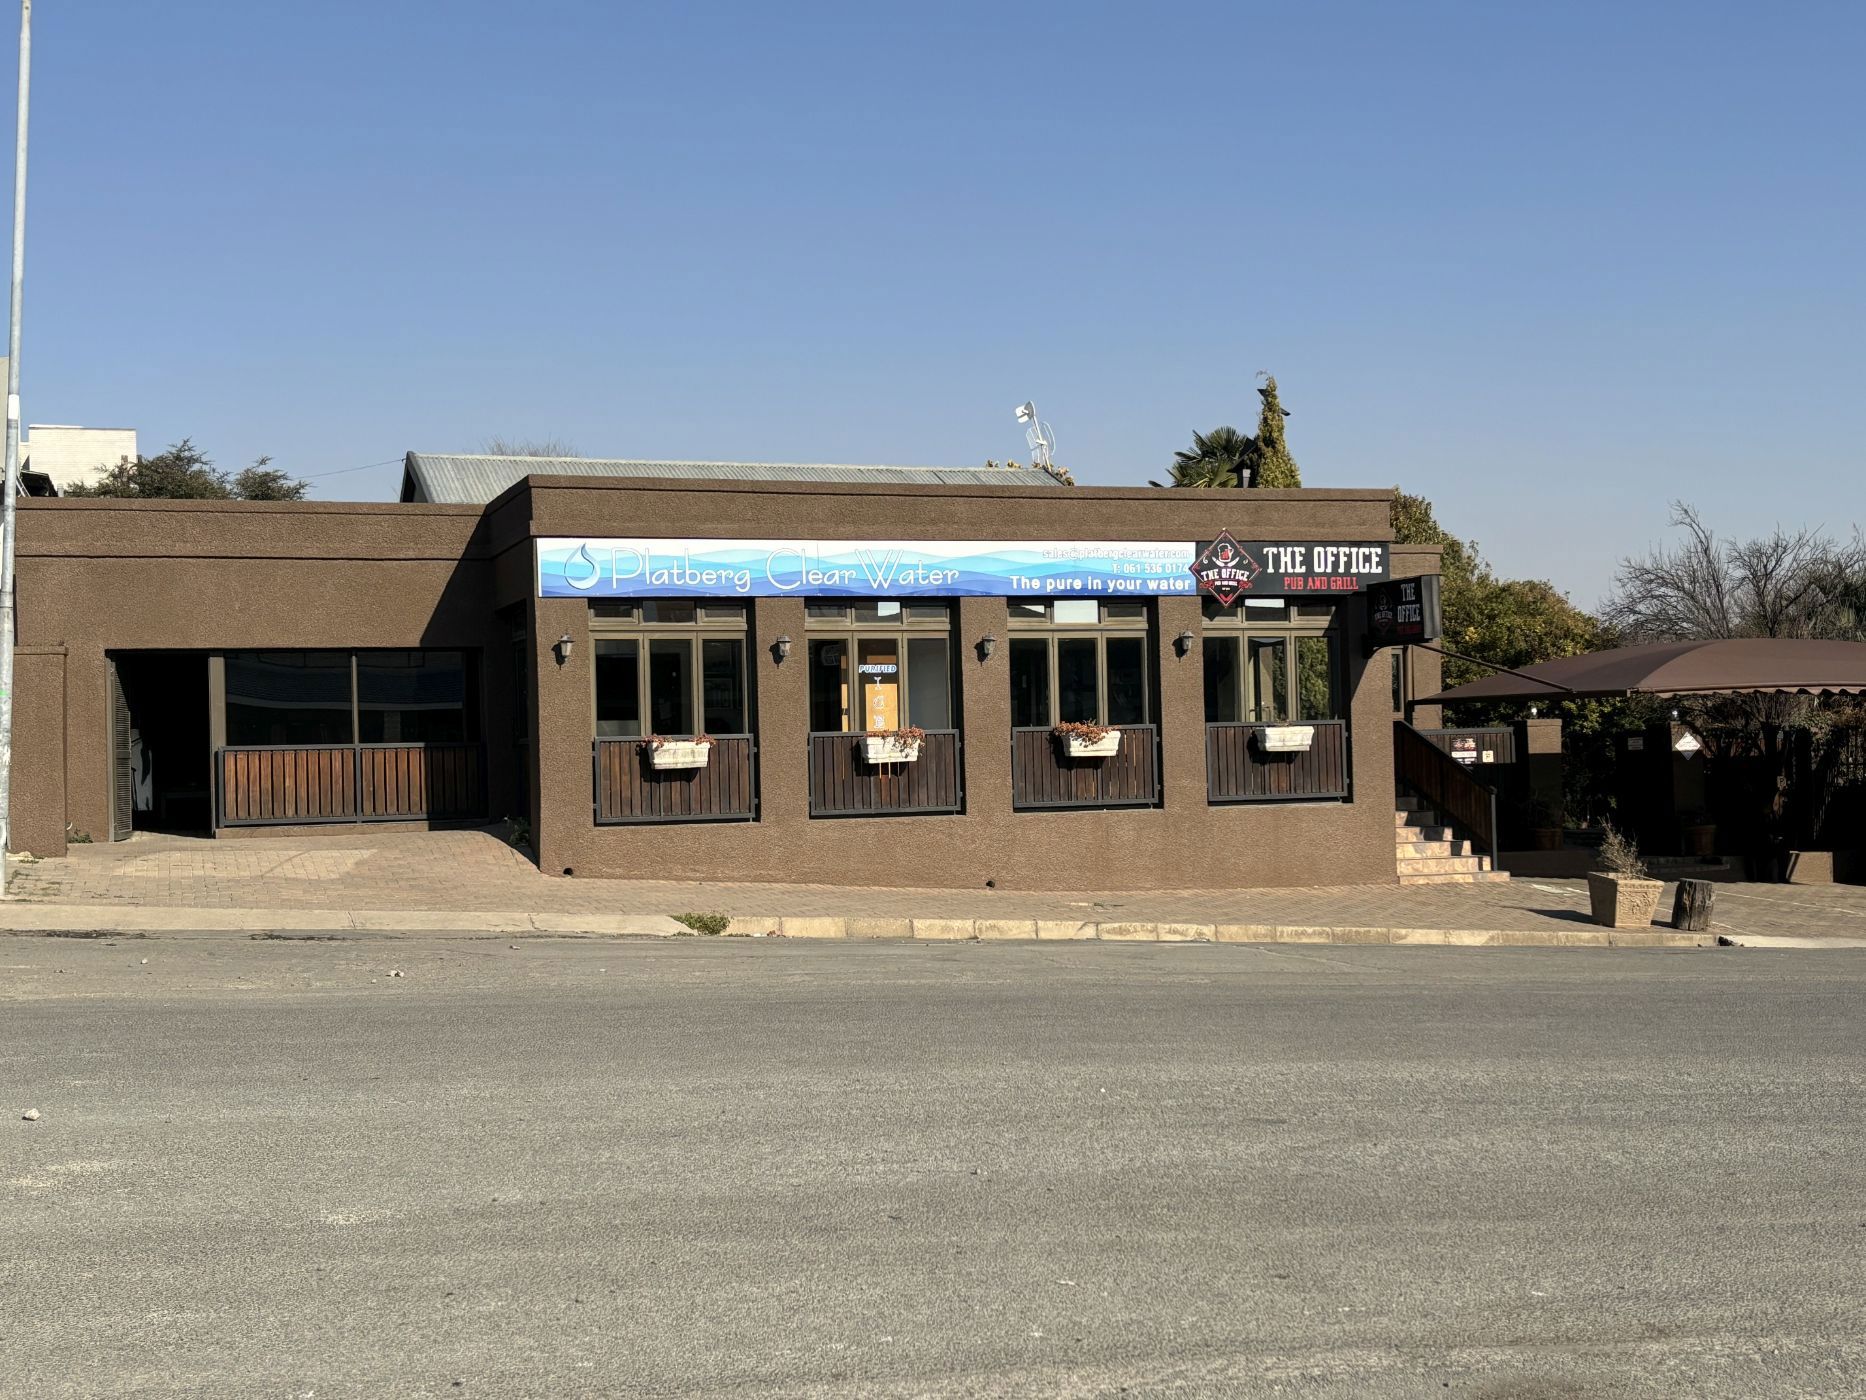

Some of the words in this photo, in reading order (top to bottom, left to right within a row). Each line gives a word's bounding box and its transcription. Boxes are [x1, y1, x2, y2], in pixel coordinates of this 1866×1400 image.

[611, 547, 751, 592] Platberg
[766, 547, 856, 591] Clear
[854, 548, 960, 590] Water
[1123, 563, 1141, 574] 061
[1145, 563, 1162, 574] 536
[1165, 563, 1190, 574] 0174
[1263, 547, 1307, 574] THE
[1313, 547, 1383, 574] OFFICE
[1201, 569, 1220, 581] THE
[1221, 568, 1250, 581] OFFICE
[1284, 576, 1304, 590] PUB
[1306, 577, 1328, 590] AND
[1330, 577, 1359, 590] GRILL
[1009, 575, 1041, 590] The
[1046, 578, 1083, 593] pure
[1088, 575, 1102, 590] in
[1107, 578, 1142, 593] your
[1147, 577, 1191, 590] water
[1400, 582, 1416, 602] THE
[1397, 604, 1421, 623] OFFICE
[859, 664, 897, 674] PURIFIED
